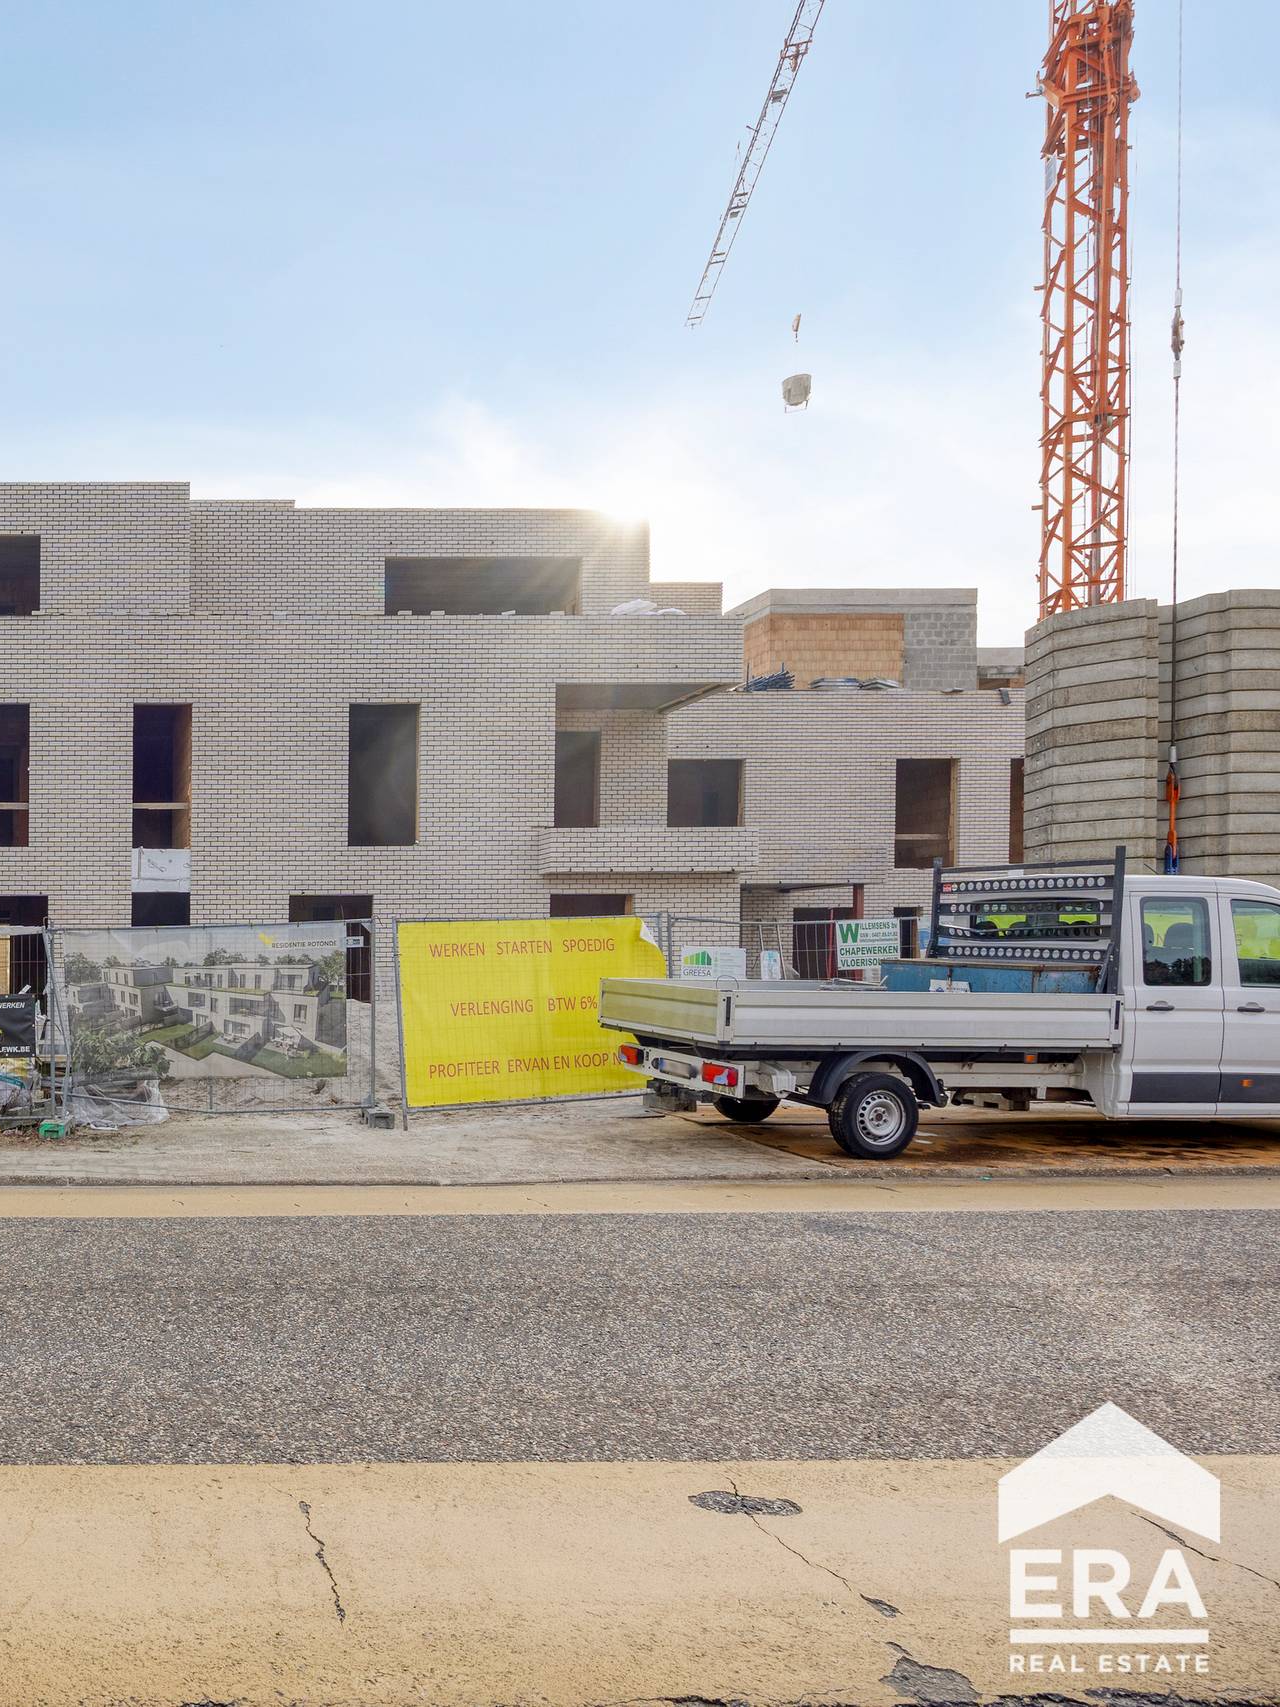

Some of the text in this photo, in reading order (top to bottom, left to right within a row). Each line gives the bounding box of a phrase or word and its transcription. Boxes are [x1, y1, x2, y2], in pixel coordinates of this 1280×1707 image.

[429, 938, 616, 958] WERKEN STARTEN SPOEDIG
[840, 945, 898, 956] CHAPEWERKEN
[683, 968, 712, 977] GREESA
[450, 996, 598, 1017] VERLENGING BTW 6%
[429, 1060, 500, 1079] PROFITEER
[507, 1057, 550, 1073] ERVAN
[554, 1055, 571, 1070] EN
[574, 1052, 609, 1068] KOOP
